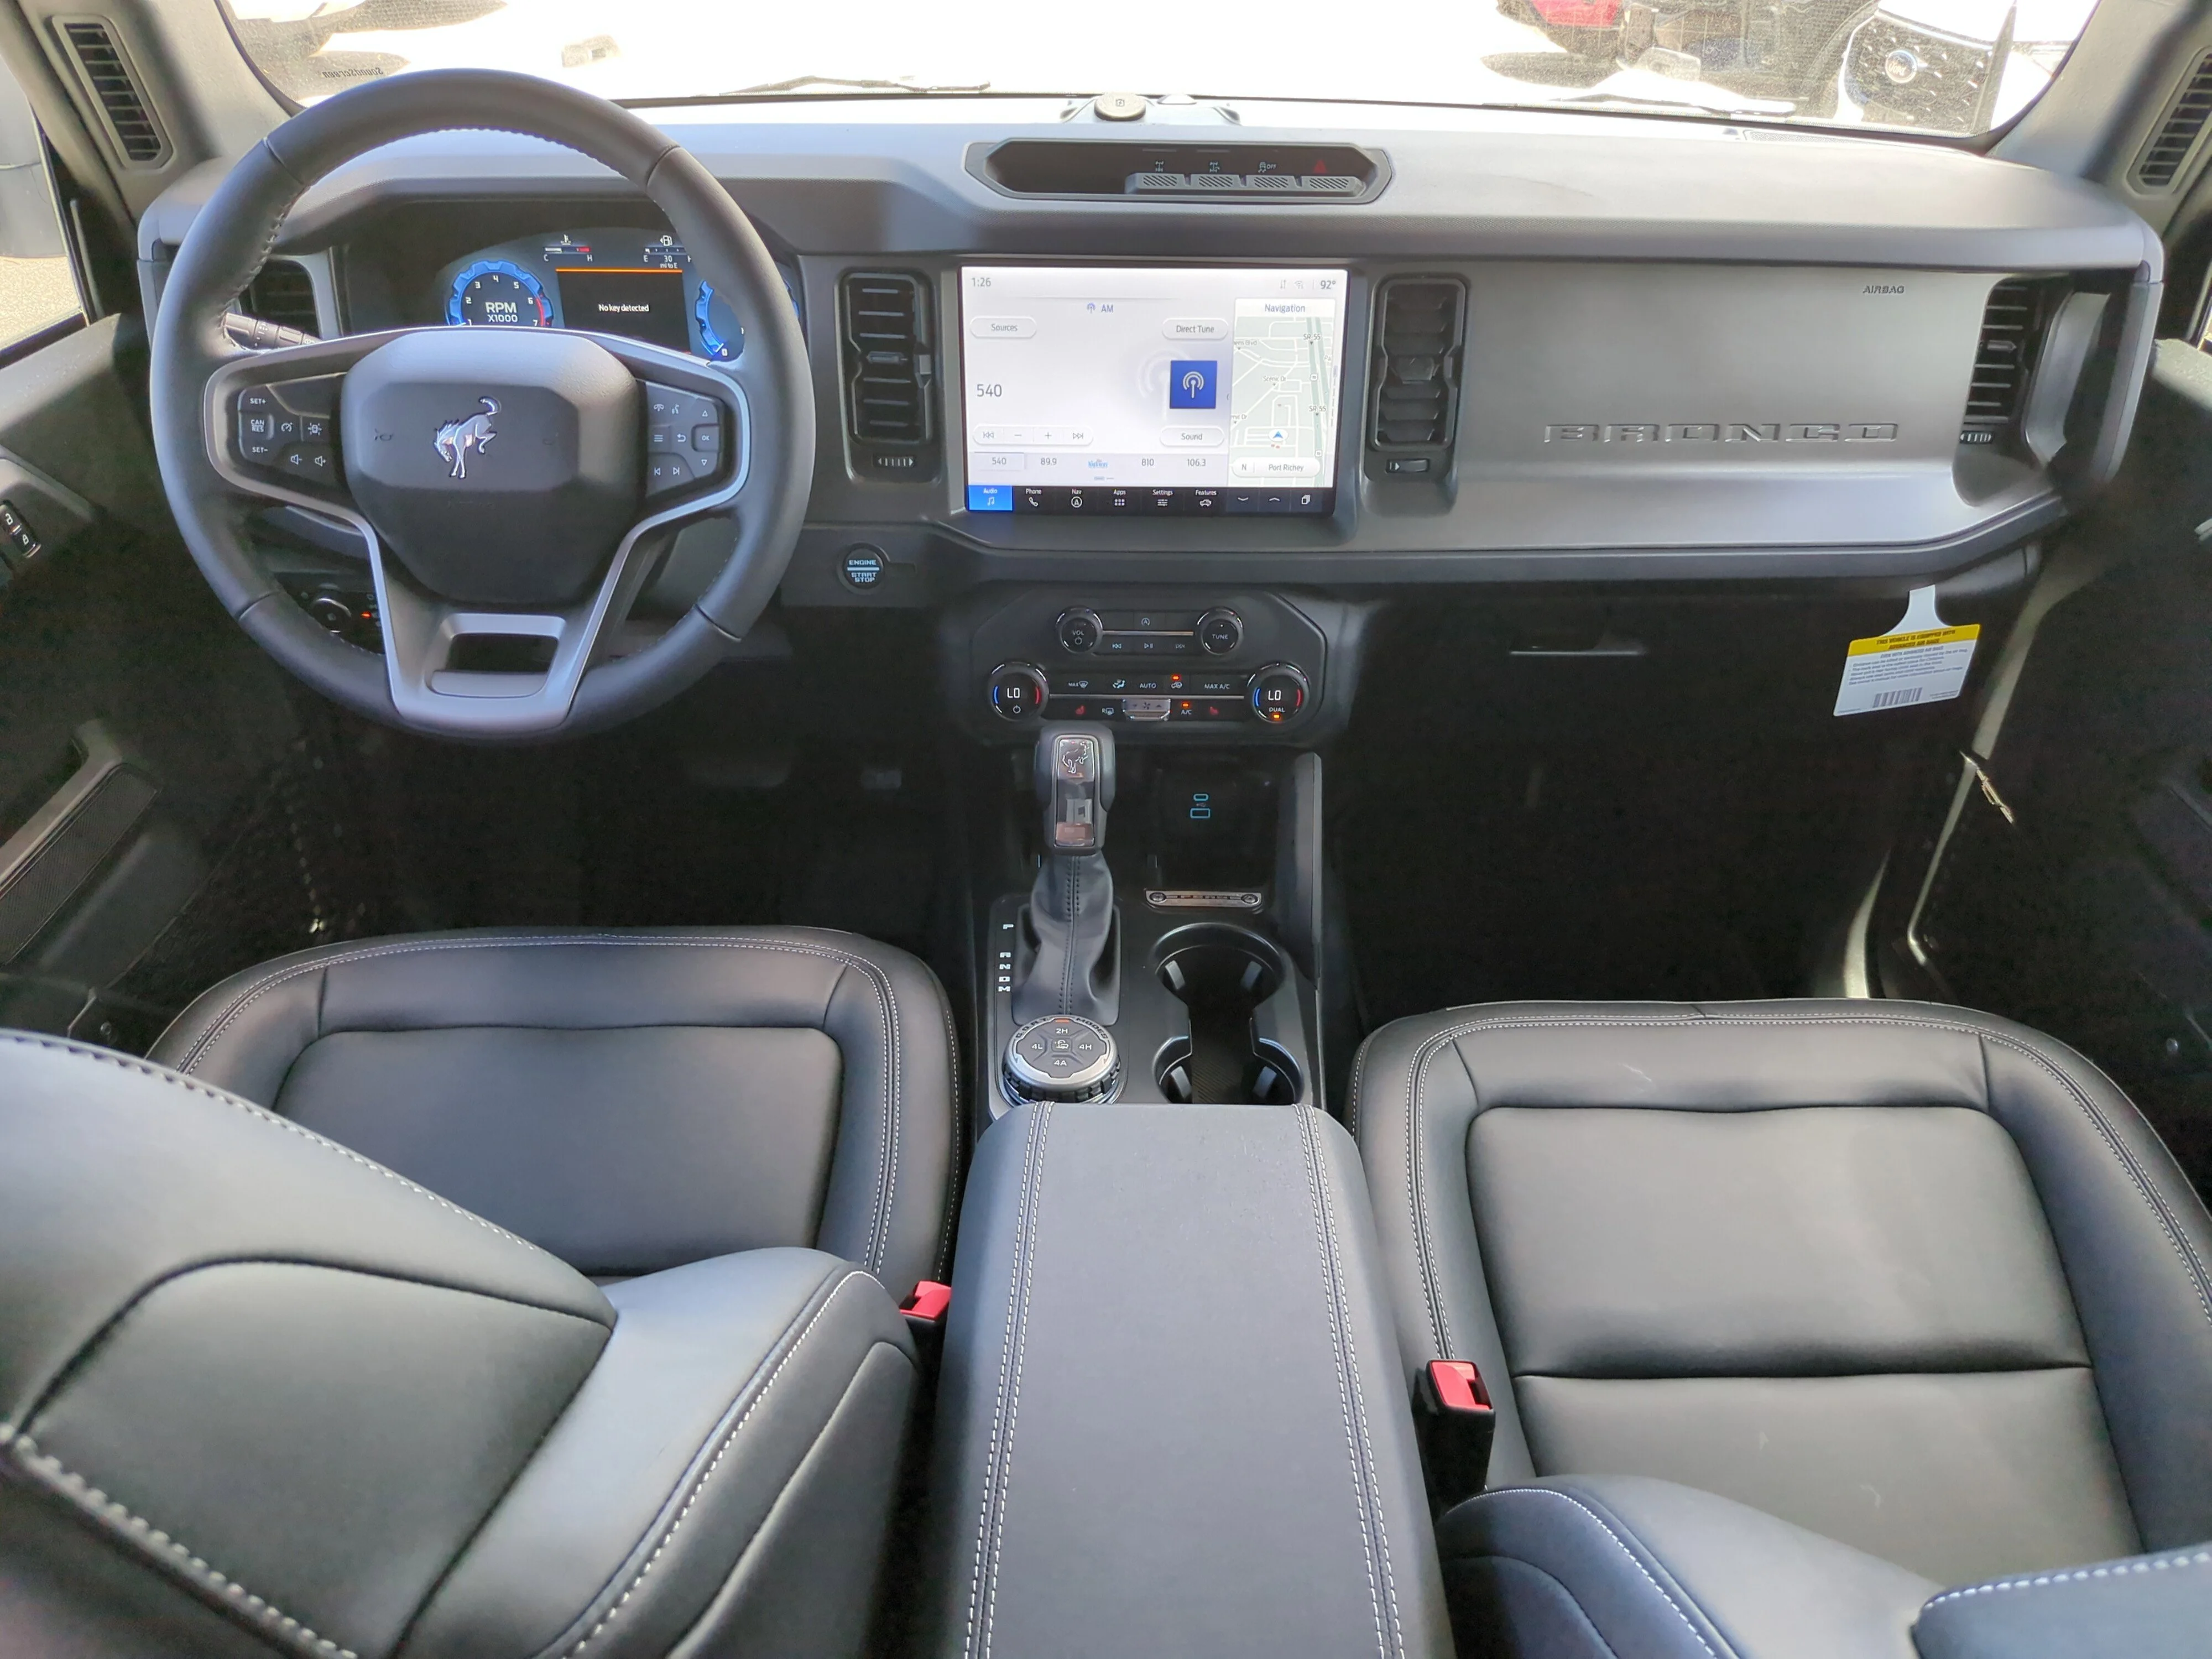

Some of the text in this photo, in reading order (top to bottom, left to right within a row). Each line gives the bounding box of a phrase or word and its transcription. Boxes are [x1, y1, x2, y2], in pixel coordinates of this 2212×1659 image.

[972, 278, 992, 287] 1:26
[1320, 280, 1336, 289] 92°
[1863, 285, 1905, 294] AIRBAG
[485, 302, 517, 313] RPM
[609, 304, 620, 313] key
[1101, 305, 1113, 313] AM
[1265, 304, 1306, 314] Navigation
[487, 314, 518, 322] X1000
[991, 324, 1018, 332] Sources
[977, 384, 1003, 398] 540
[1545, 424, 1898, 442] BRONCO
[1007, 687, 1020, 698] LO
[1268, 690, 1281, 701] LO
[1076, 1018, 1109, 1039] MODES
